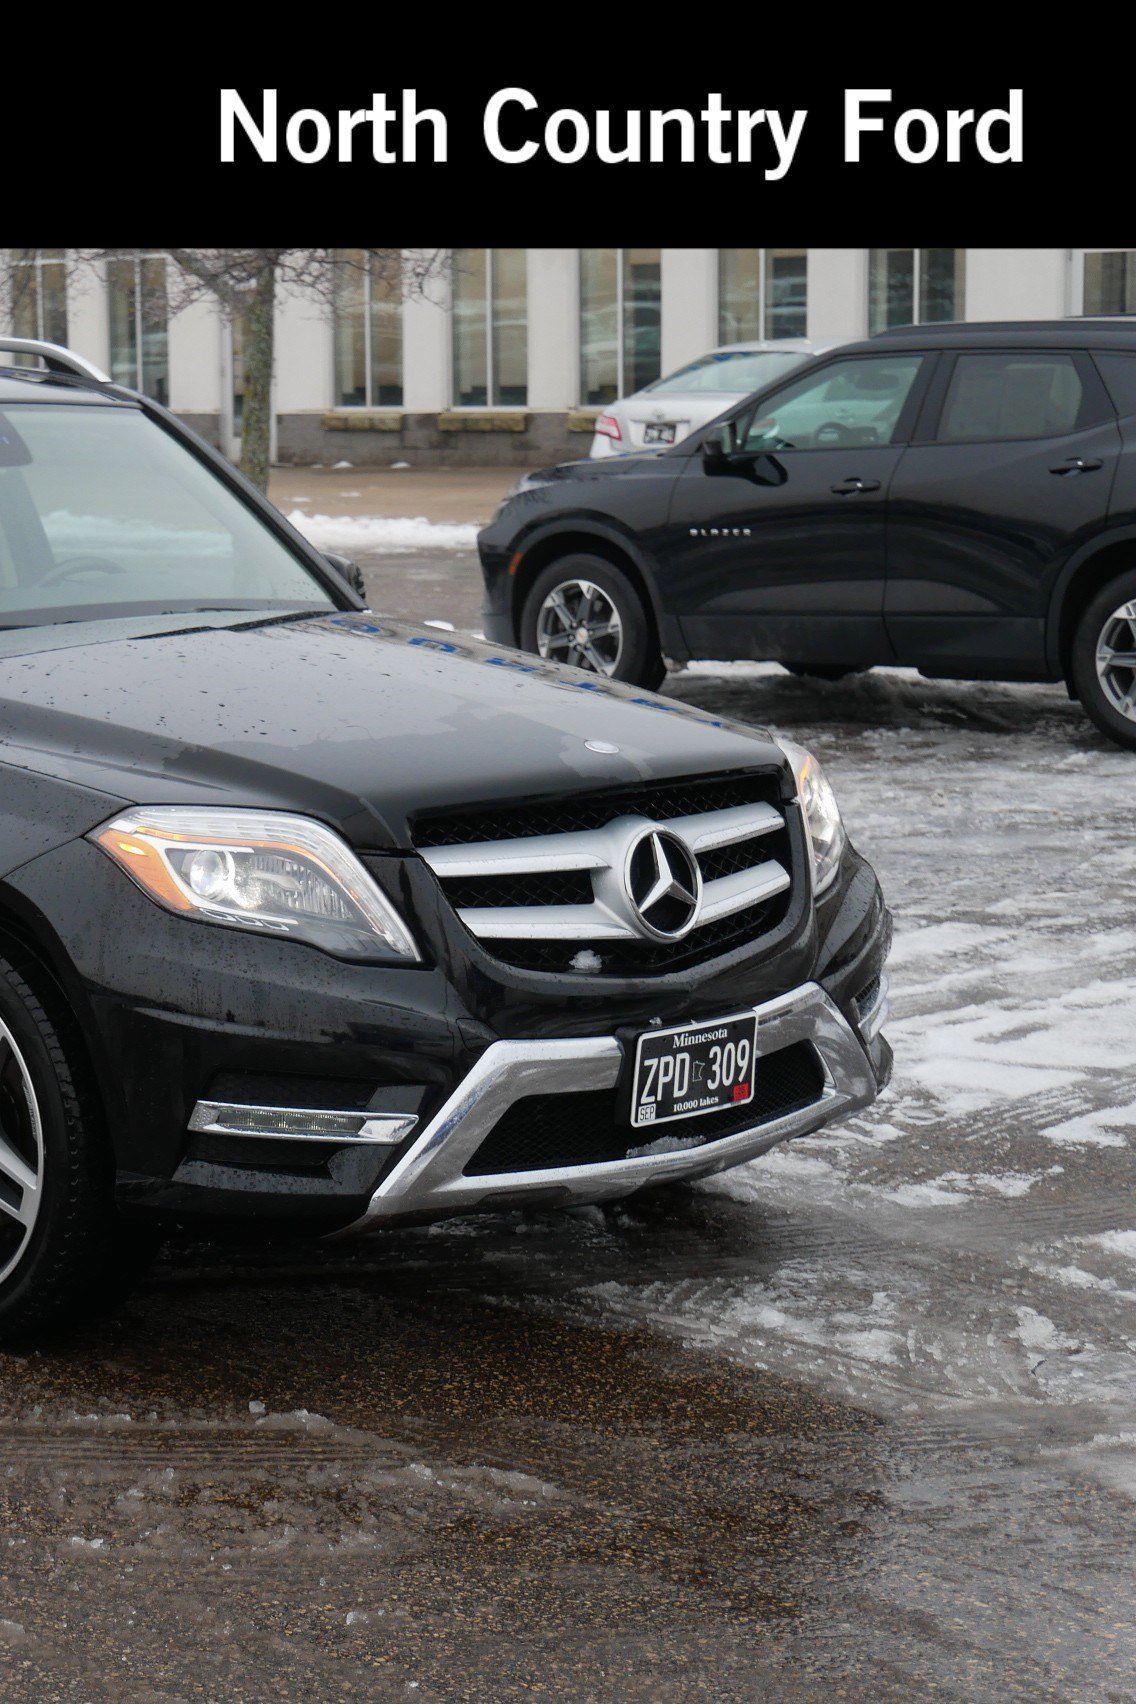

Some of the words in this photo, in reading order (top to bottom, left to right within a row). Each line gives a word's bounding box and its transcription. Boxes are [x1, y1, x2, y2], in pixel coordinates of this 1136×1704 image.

[689, 528, 751, 537] BLAZER
[672, 1027, 728, 1049] Minnesota
[640, 1052, 691, 1104] ZPD
[707, 1038, 750, 1090] 309
[673, 1100, 698, 1112] 10,000
[699, 1095, 719, 1107] lakes
[639, 1105, 655, 1121] SEP
